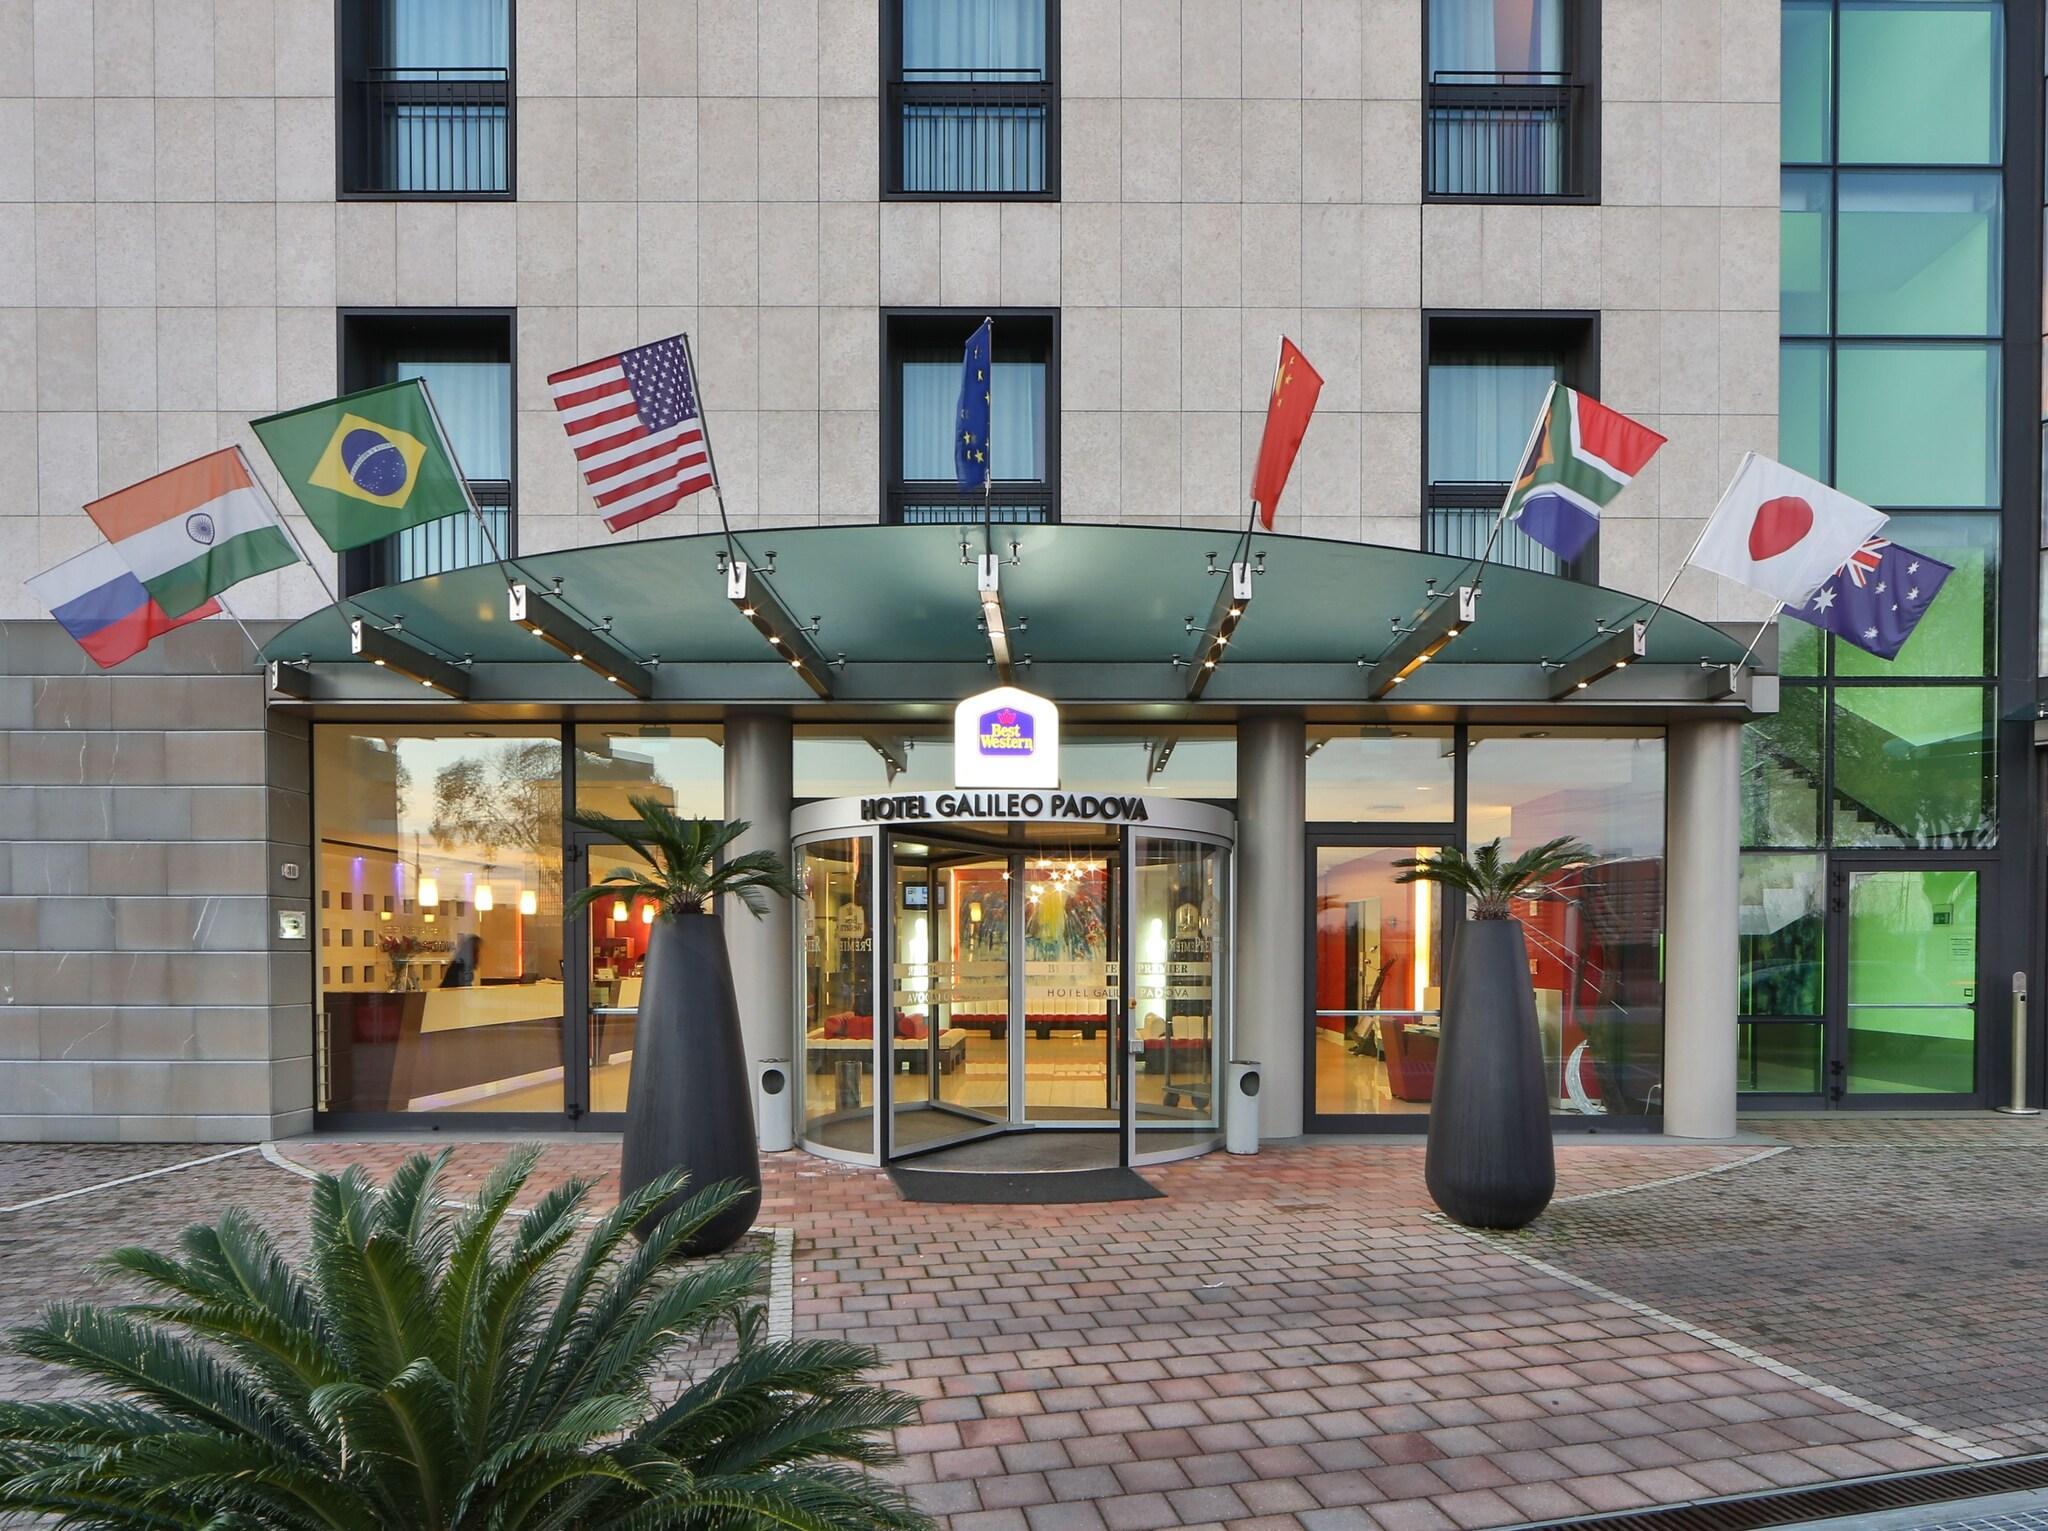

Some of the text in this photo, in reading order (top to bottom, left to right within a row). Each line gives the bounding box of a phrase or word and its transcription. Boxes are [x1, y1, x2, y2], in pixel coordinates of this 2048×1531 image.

[991, 723, 1021, 738] Best
[980, 735, 1034, 752] Western
[861, 793, 1149, 821] HOTEL GALILEO PADOVA
[1047, 988, 1089, 998] HOTEL
[1140, 988, 1190, 998] PADOVA
